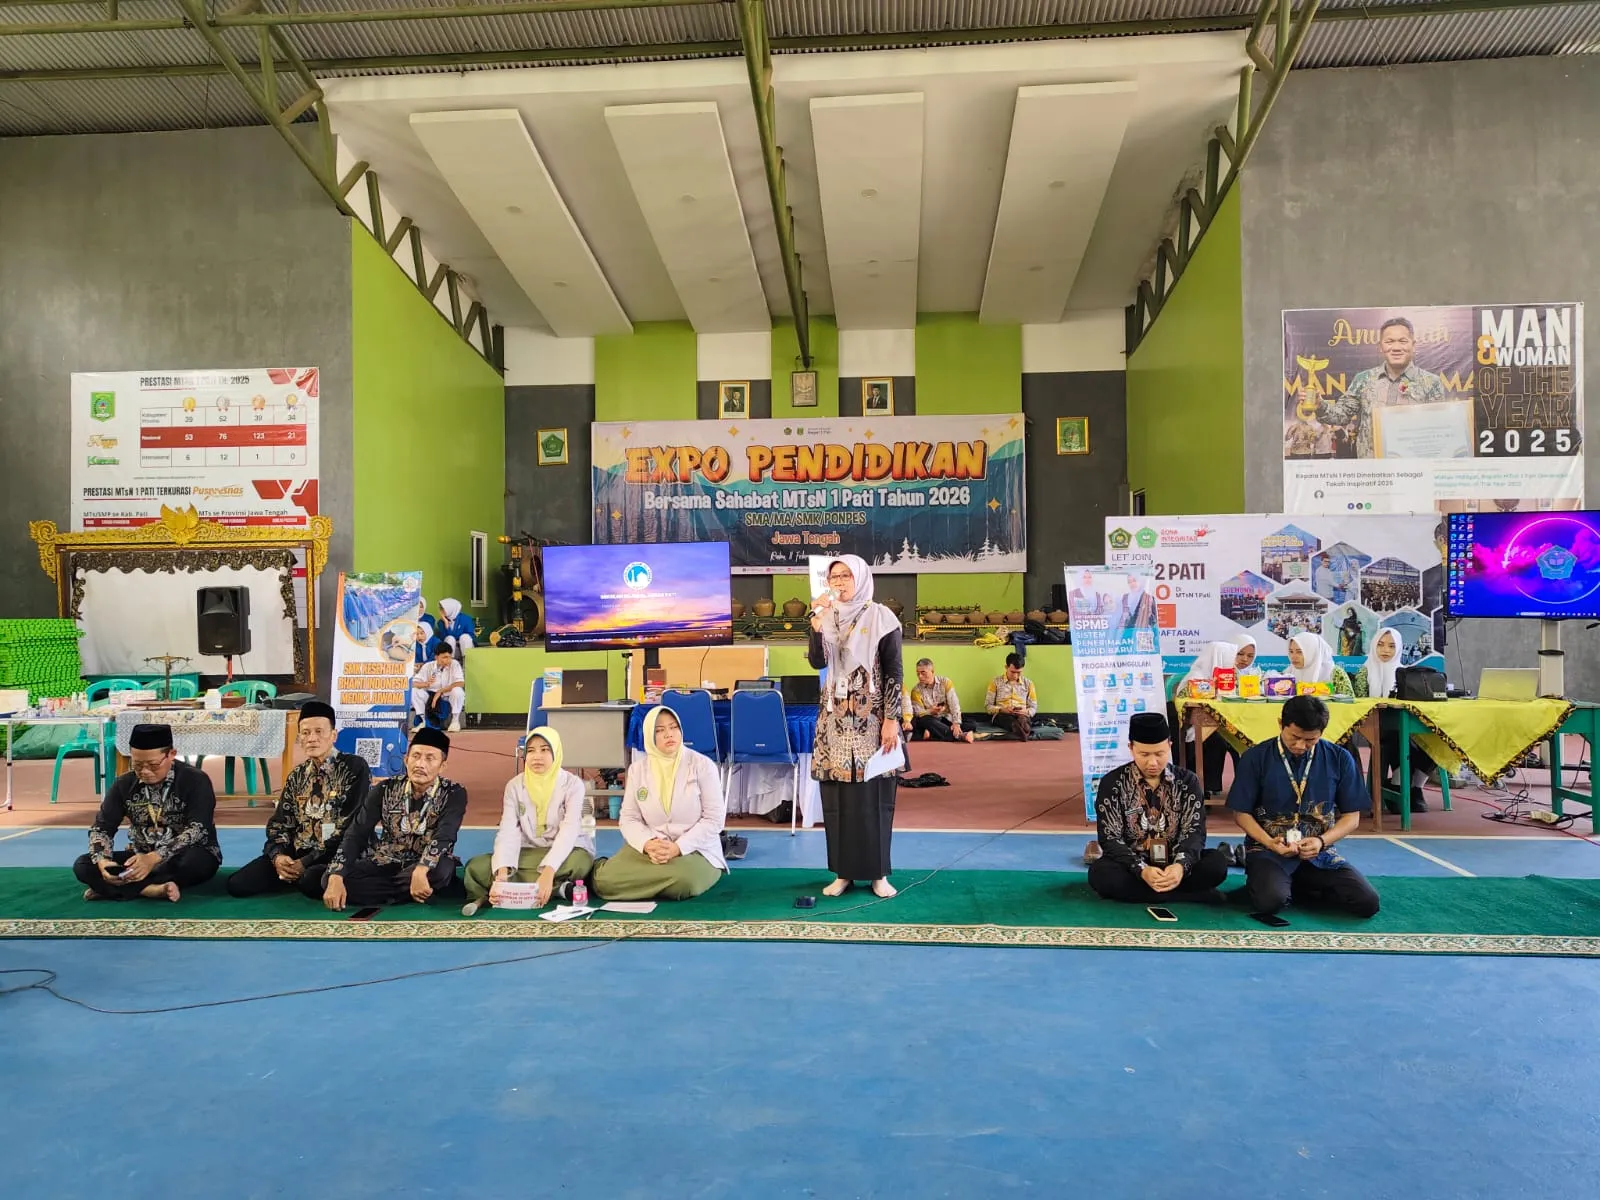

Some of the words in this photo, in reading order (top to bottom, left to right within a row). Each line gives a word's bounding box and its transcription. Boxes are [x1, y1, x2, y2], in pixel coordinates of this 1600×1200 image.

[1481, 308, 1571, 348] MAN
[1477, 335, 1496, 365] &
[1496, 346, 1570, 366] WOMAN
[140, 376, 172, 387] PRESTASI
[230, 375, 250, 385] 2025
[1479, 367, 1511, 395] OF
[1519, 366, 1570, 394] THE
[1480, 393, 1570, 429] YEAR
[1479, 429, 1571, 453] 2025
[624, 445, 731, 484] EXPO
[746, 440, 988, 483] PENDIDIKAN
[83, 487, 113, 497] PRESTASI
[115, 487, 133, 496] MTsN
[141, 487, 155, 496] PATI
[156, 486, 192, 496] TERKURASI
[644, 491, 712, 509] Bersama
[715, 489, 779, 510] Sahabat
[782, 488, 827, 508] MTsN
[831, 488, 839, 507] 1
[842, 488, 874, 508] Pati
[878, 487, 925, 507] Tahun
[929, 486, 971, 506] 2026
[745, 511, 867, 527] SMA/MA/SMK/PONPES
[771, 531, 801, 545] Jawa
[802, 530, 841, 548] Tengah
[1155, 563, 1166, 580] 2
[1168, 562, 1205, 580] PATI
[1075, 620, 1109, 630] SPMB
